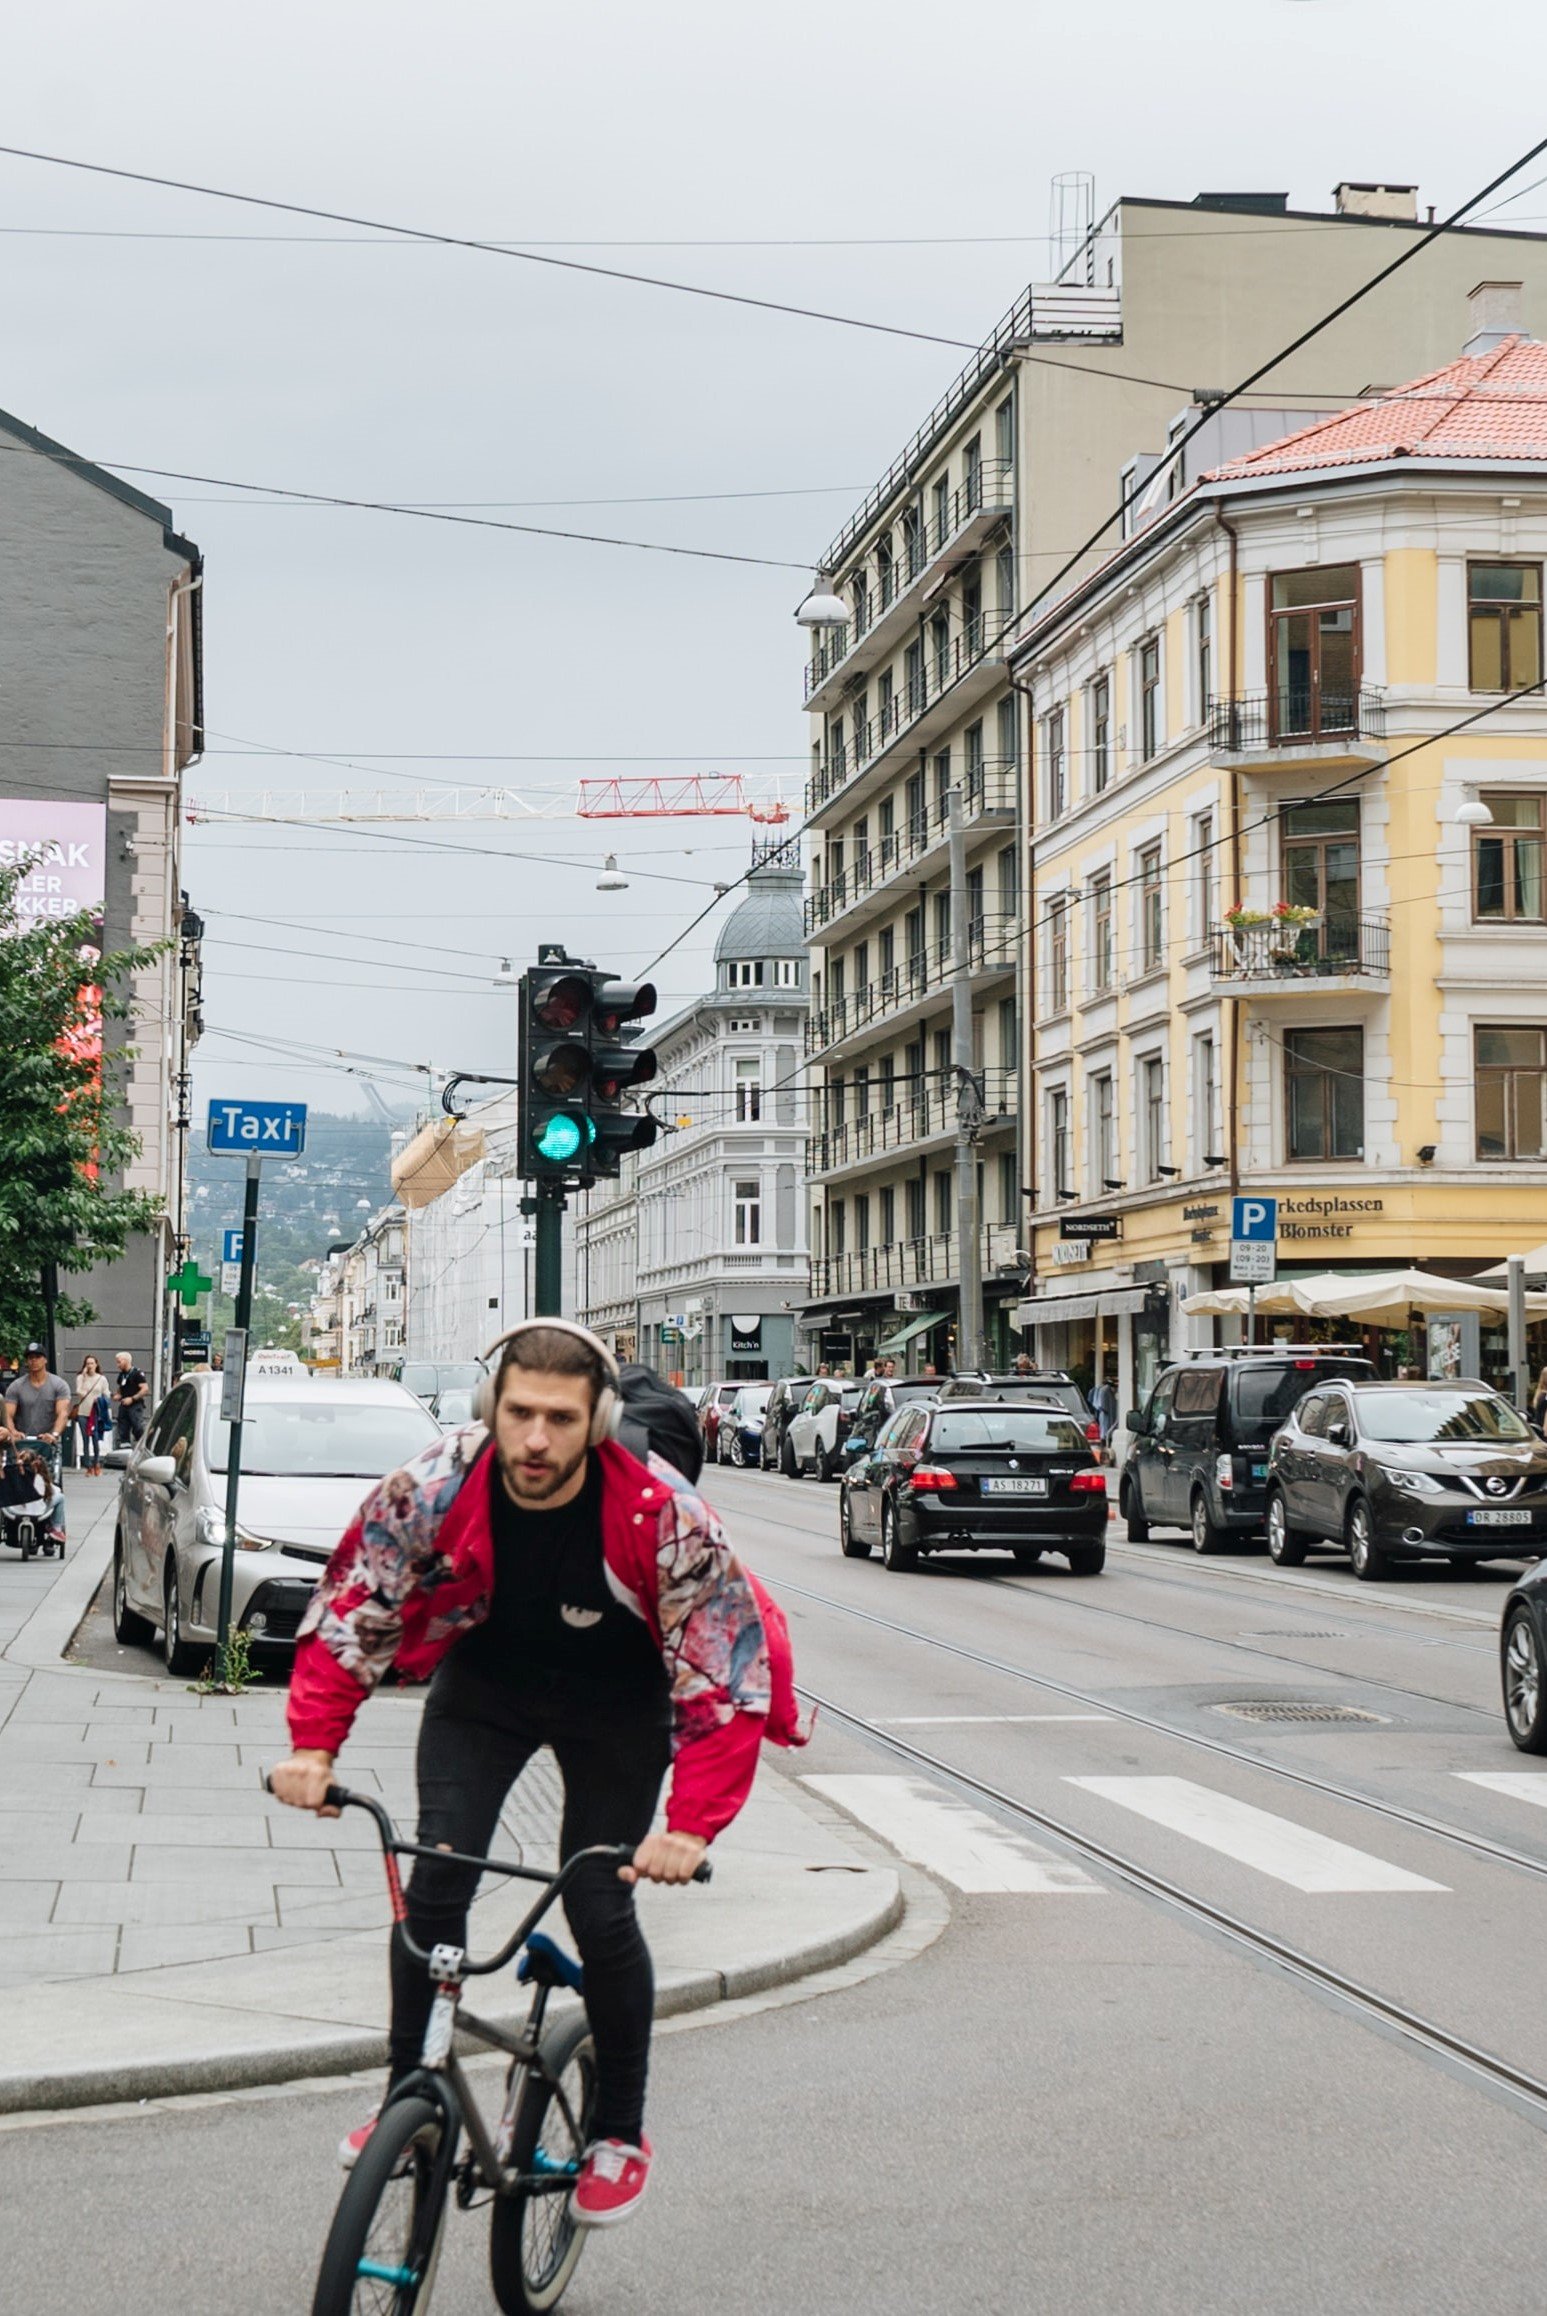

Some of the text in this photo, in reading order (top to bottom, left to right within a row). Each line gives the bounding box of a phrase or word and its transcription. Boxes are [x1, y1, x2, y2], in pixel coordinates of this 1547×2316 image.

[18, 876, 62, 893] LER
[11, 896, 78, 915] KKER
[222, 1107, 292, 1141] Taxi
[1278, 1197, 1383, 1216] rkedsplassen
[1243, 1203, 1266, 1235] P
[1280, 1222, 1353, 1239] Blomster
[733, 1341, 759, 1349] Kitch'n
[259, 1366, 293, 1376] A 1341
[994, 1481, 1040, 1490] AS 18271
